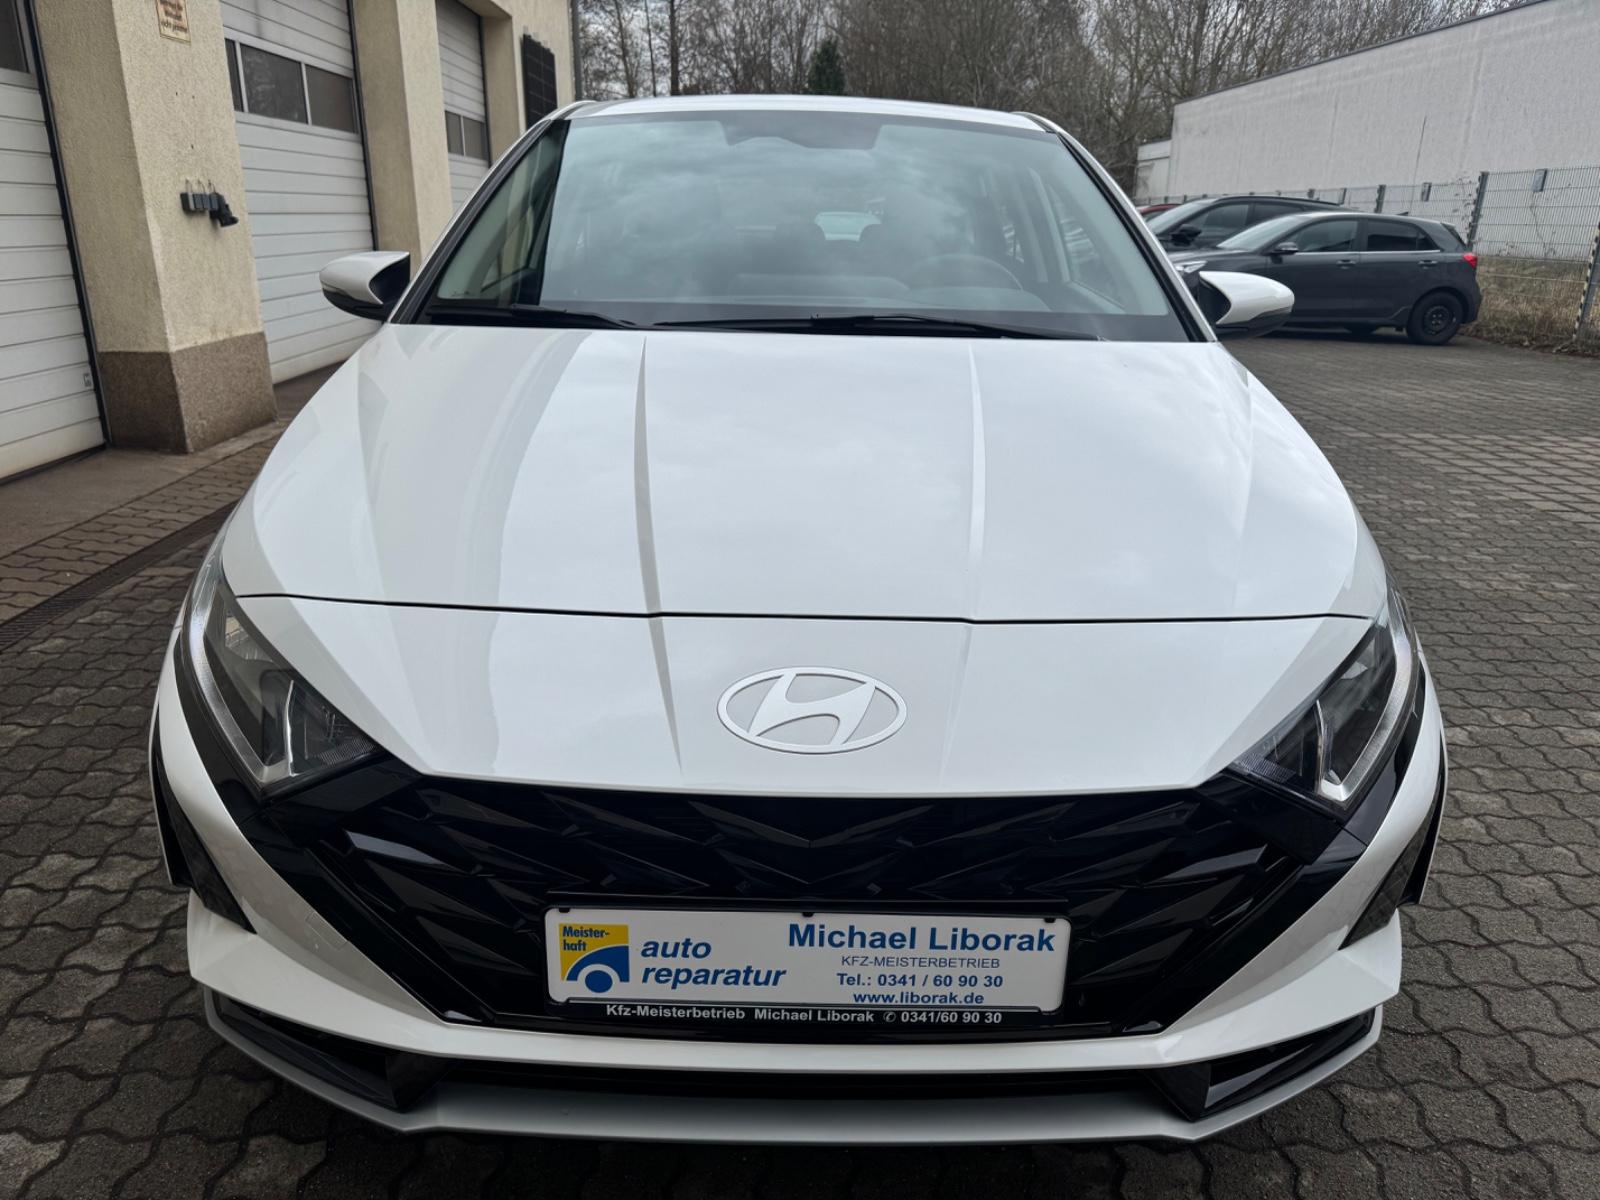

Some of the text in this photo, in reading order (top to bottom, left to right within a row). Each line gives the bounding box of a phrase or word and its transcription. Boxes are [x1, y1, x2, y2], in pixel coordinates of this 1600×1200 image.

[562, 926, 610, 939] Meister-
[788, 923, 1056, 952] Michael Liborak
[562, 939, 588, 952] haft
[640, 938, 712, 960] auto
[841, 955, 1001, 970] KFZ-MEISTERBETRIEB
[641, 965, 788, 991] reparatur
[836, 972, 1004, 988] Tel.: 0341 / 60 90 30
[853, 990, 985, 1006] www.liborak.de
[605, 1003, 1003, 1025] Kfz-Meisterbetrieb Michael Liborak 0341/60 90 30
